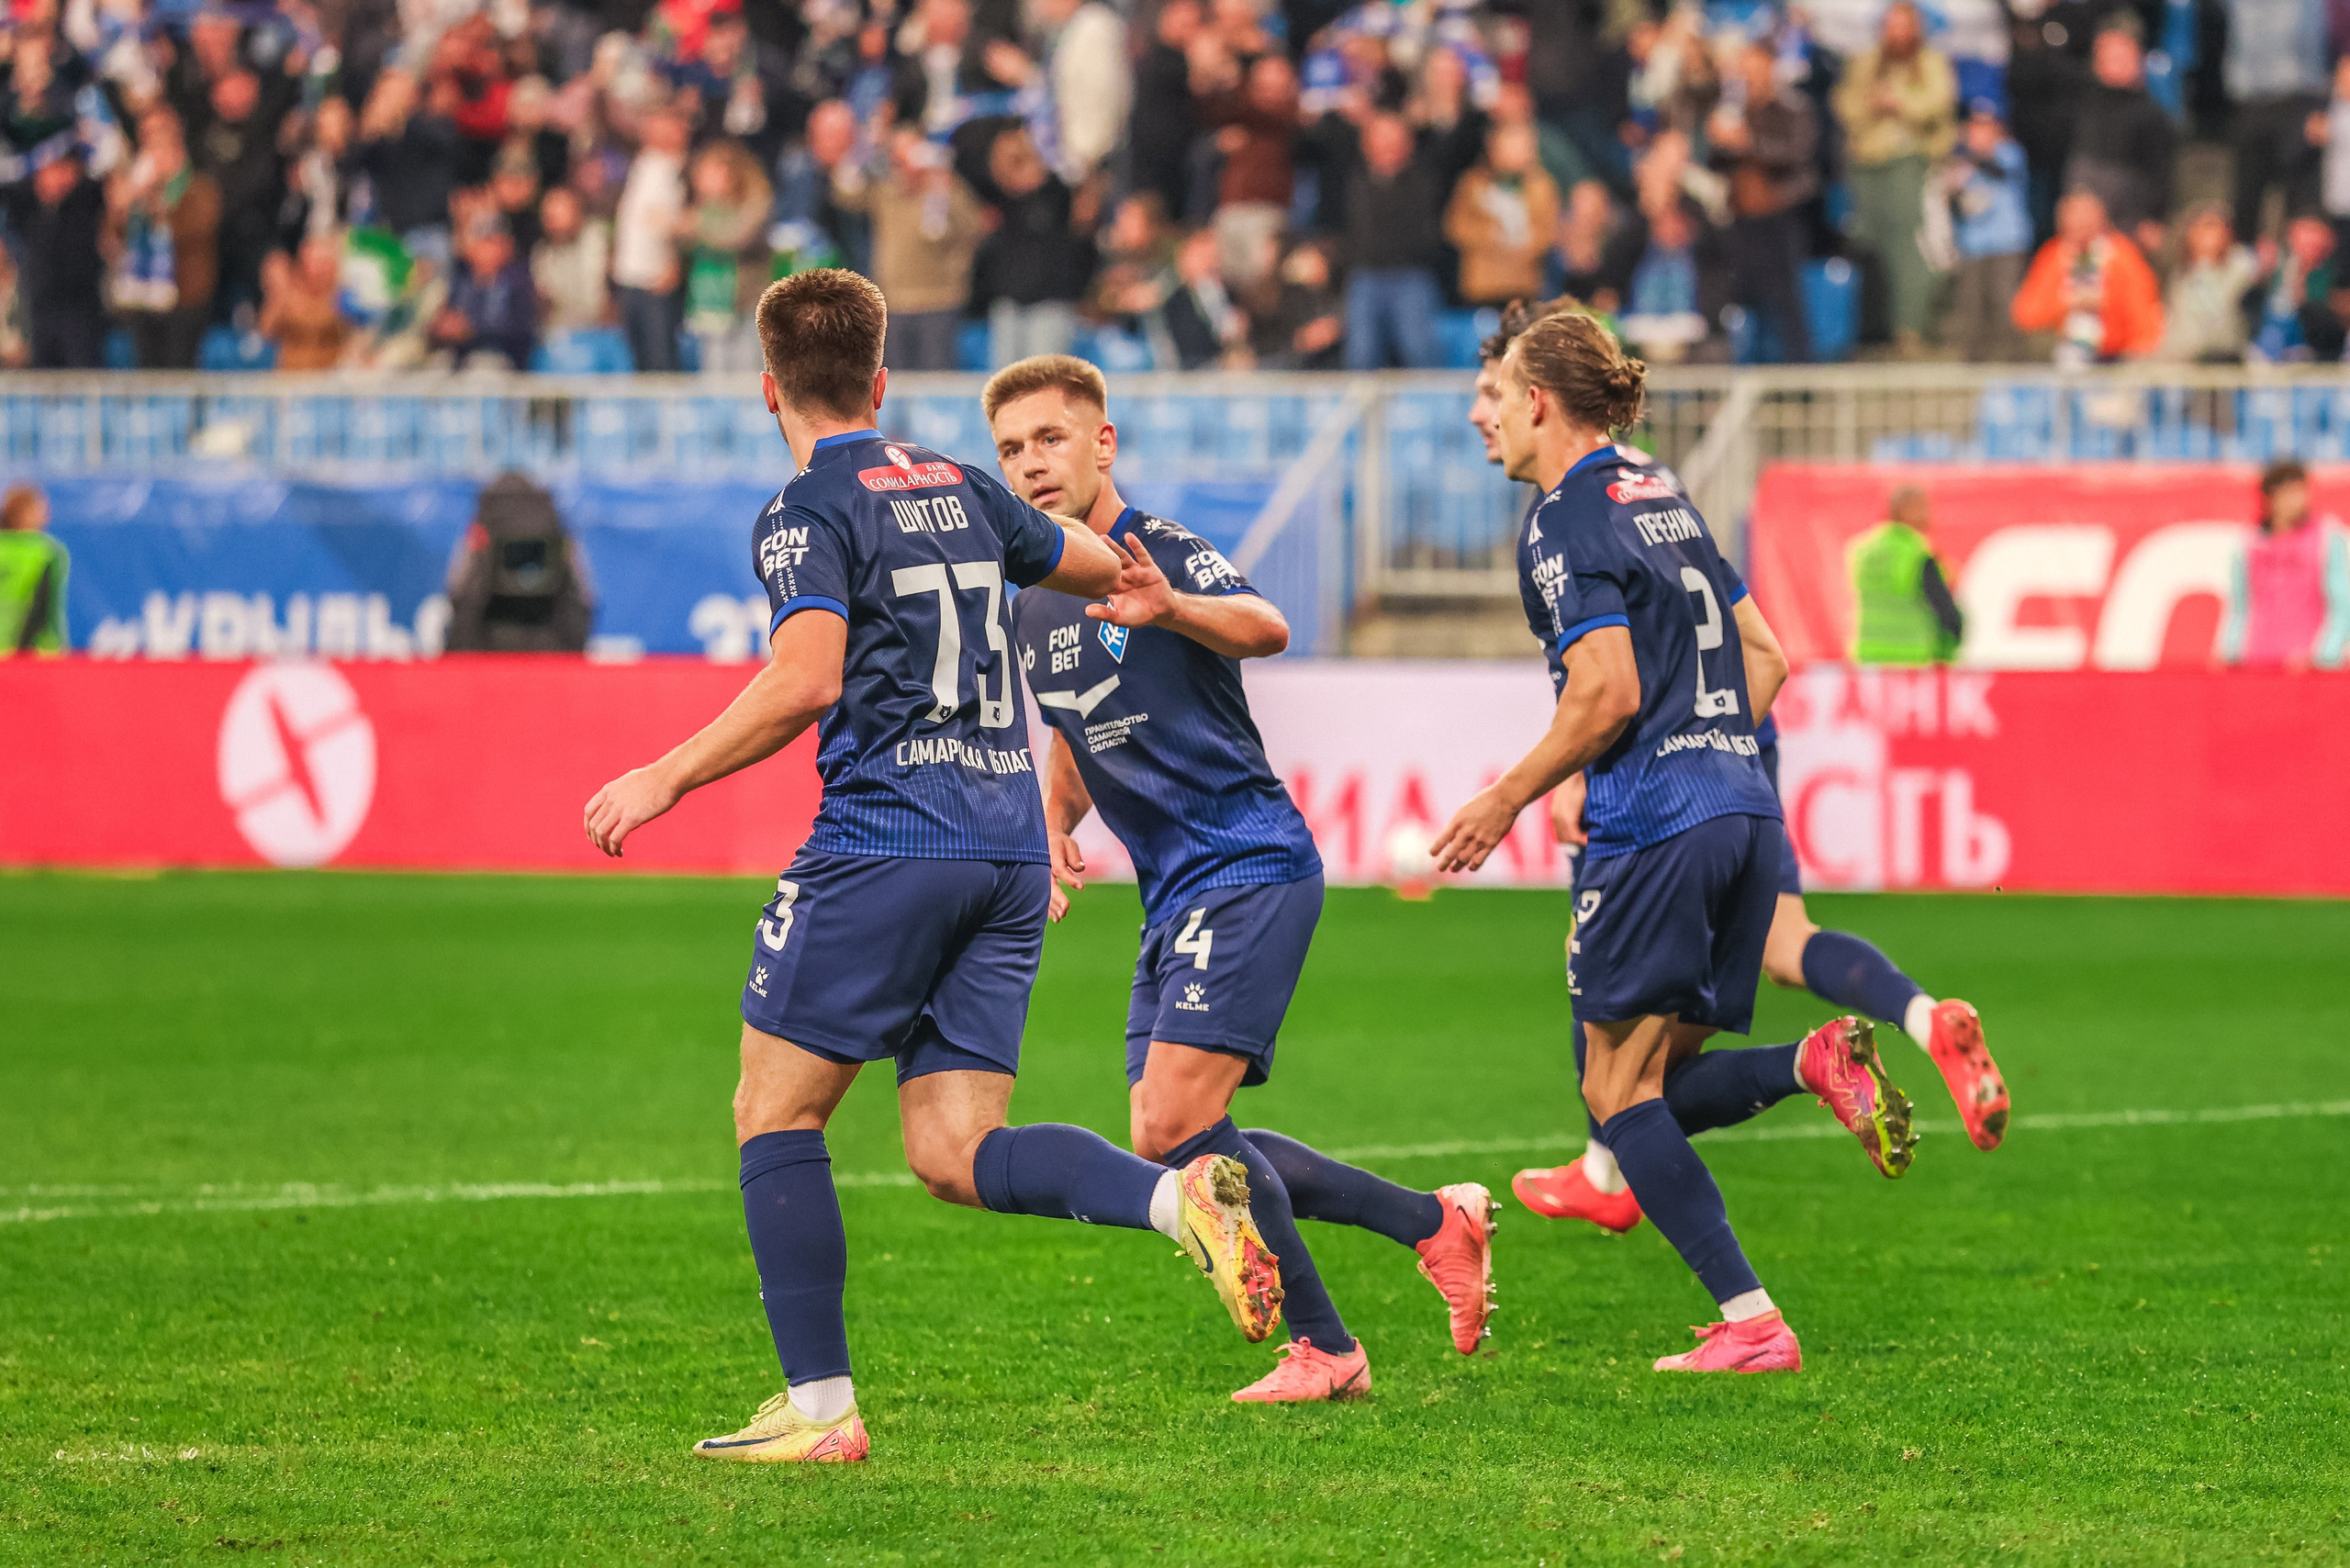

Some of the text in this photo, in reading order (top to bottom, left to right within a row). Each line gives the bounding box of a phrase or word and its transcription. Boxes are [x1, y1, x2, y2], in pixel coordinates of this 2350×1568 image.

[868, 472, 957, 489] СОЛИДАРНОСТЬ
[925, 464, 946, 472] БАНК
[890, 496, 969, 532] ШИТОВ
[760, 526, 809, 560] FON
[763, 546, 810, 580] BET
[890, 561, 1014, 729] 73
[1048, 622, 1080, 652] FON
[1680, 566, 1740, 719] 2
[1051, 644, 1082, 675] BET
[988, 747, 1032, 775] ОБЛАС
[757, 879, 800, 952] 3
[1174, 907, 1214, 970] 4
[749, 980, 767, 999] KELME
[1175, 1001, 1209, 1012] KELME
